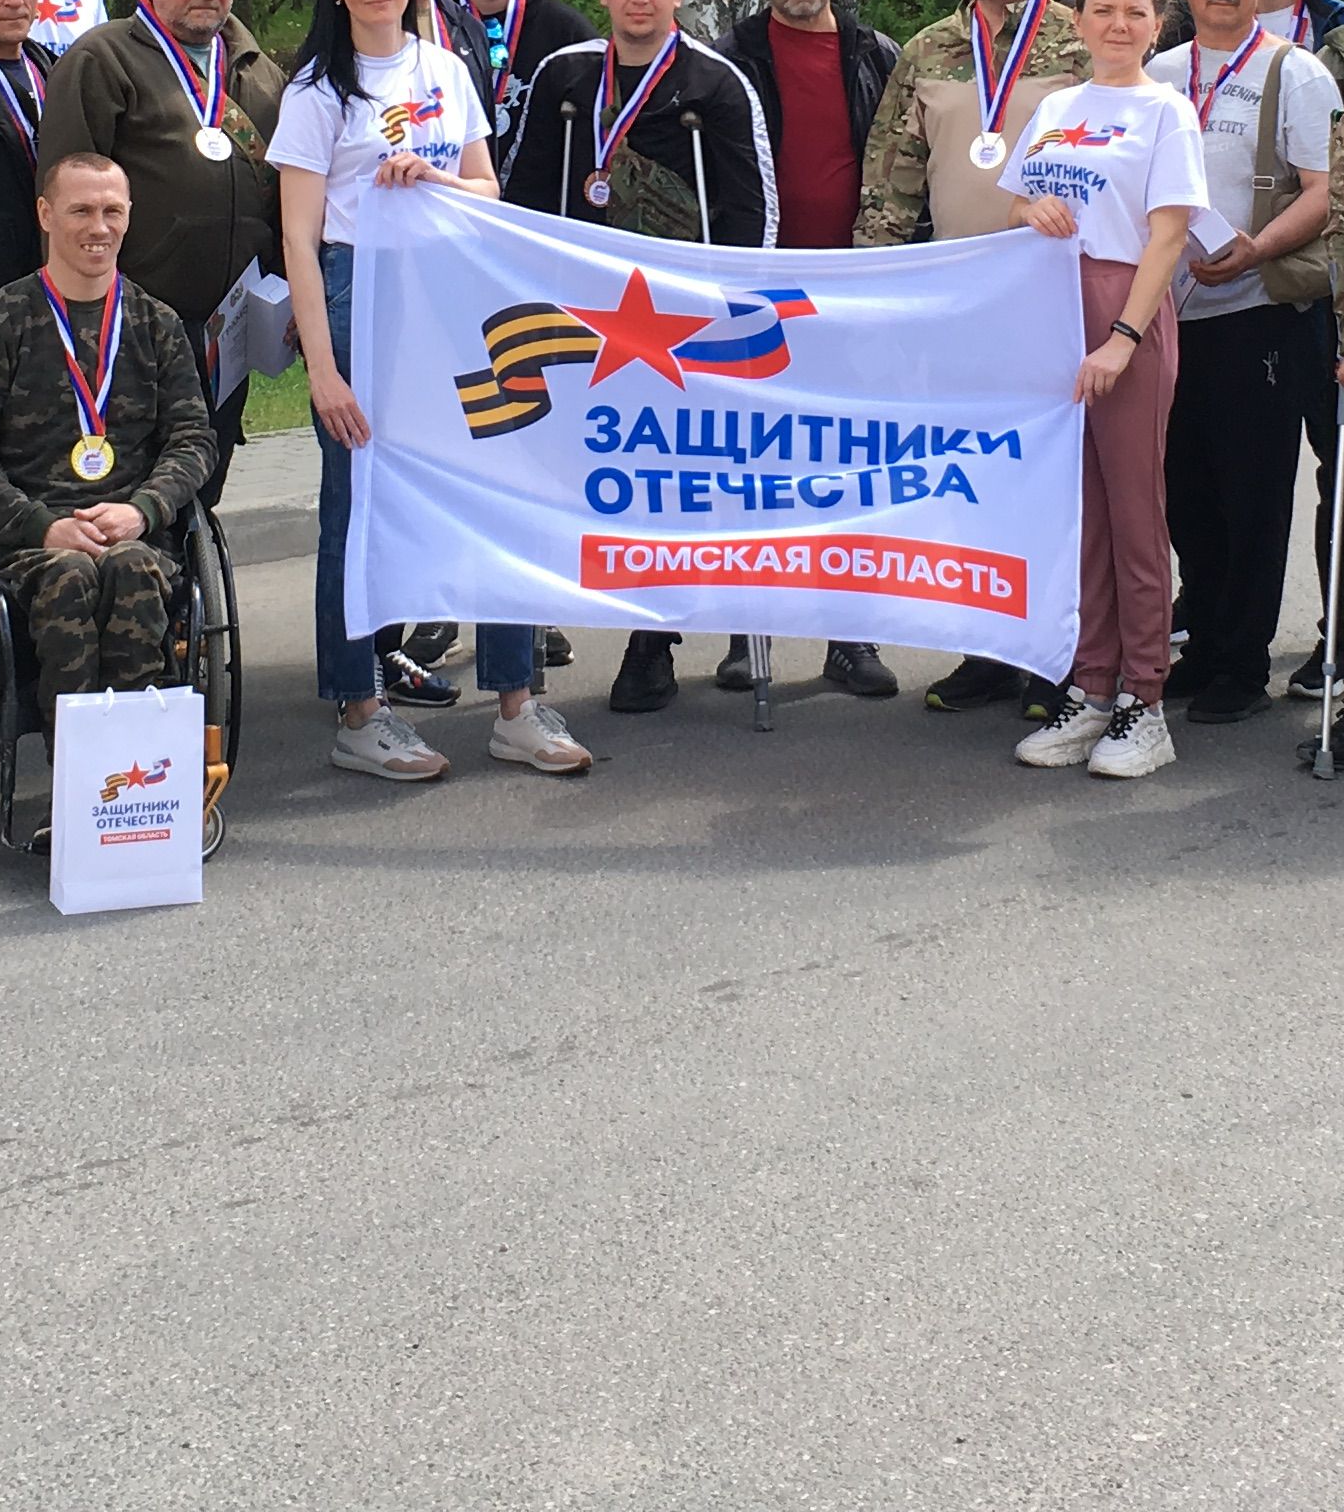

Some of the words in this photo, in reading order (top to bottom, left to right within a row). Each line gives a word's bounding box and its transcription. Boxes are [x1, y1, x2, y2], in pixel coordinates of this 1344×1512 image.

[1218, 120, 1248, 136] CITY
[1021, 161, 1107, 192] АЩИТНИКИ
[584, 405, 1022, 466] ЗАЩИТНИКИ
[585, 463, 979, 514] ОТЕЧЕСТВА
[598, 545, 811, 574] ТОМСКАЯ
[820, 547, 1013, 598] ОБЛАСТЬ
[92, 800, 180, 817] ЗАЩИТНИКИ
[96, 813, 174, 829] ОТЕЧЕСТВА
